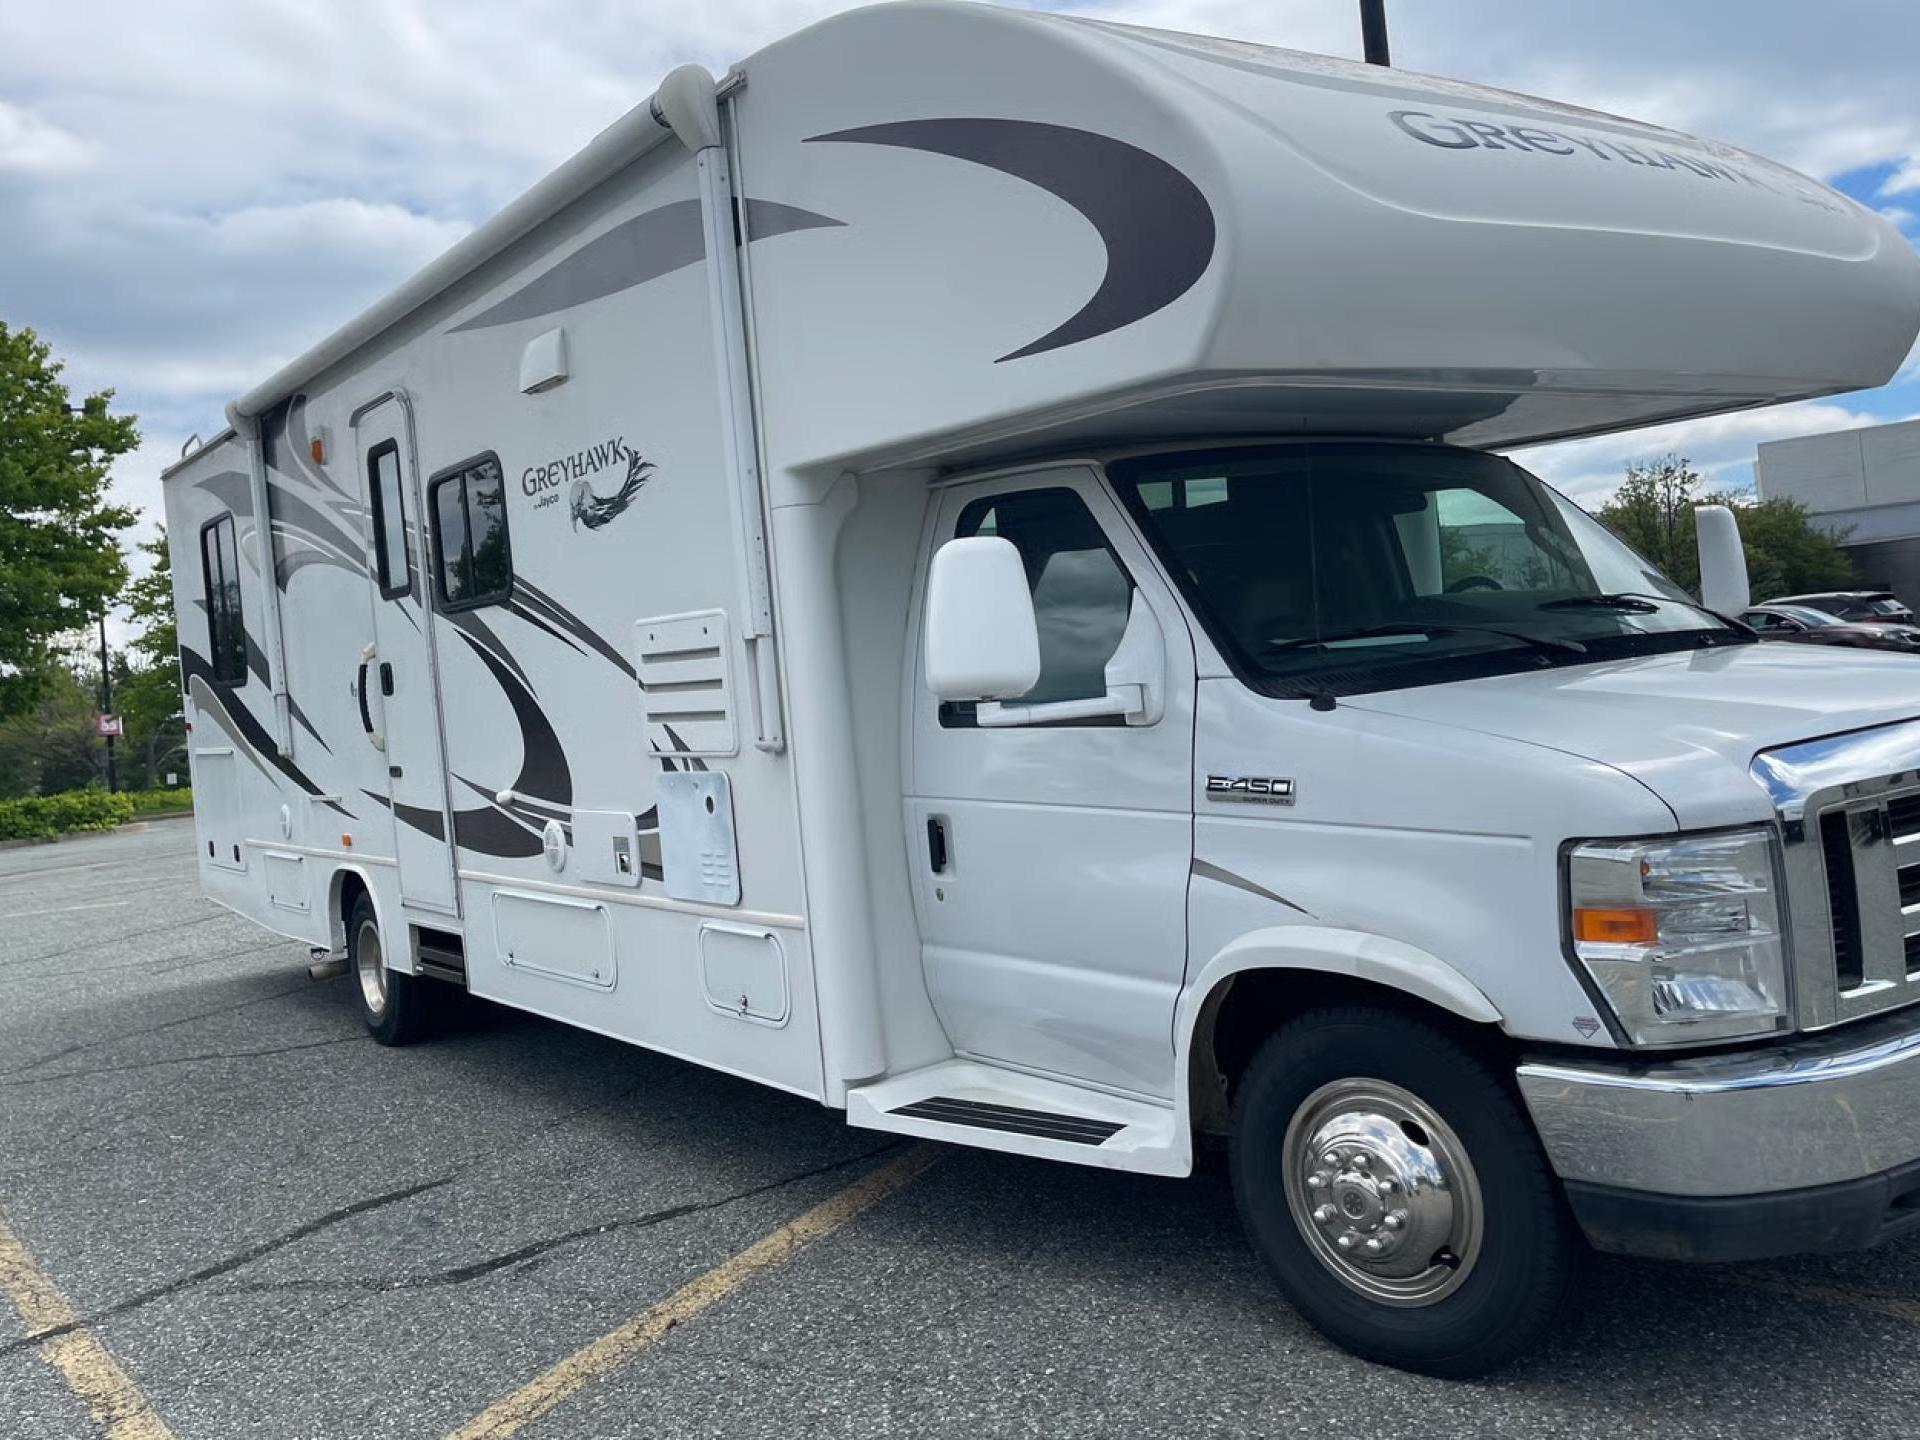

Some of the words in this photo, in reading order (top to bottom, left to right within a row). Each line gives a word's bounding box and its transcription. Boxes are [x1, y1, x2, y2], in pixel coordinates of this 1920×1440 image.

[522, 436, 626, 496] GREYHAWK
[540, 494, 560, 508] Jayco
[1206, 775, 1293, 795] E-450
